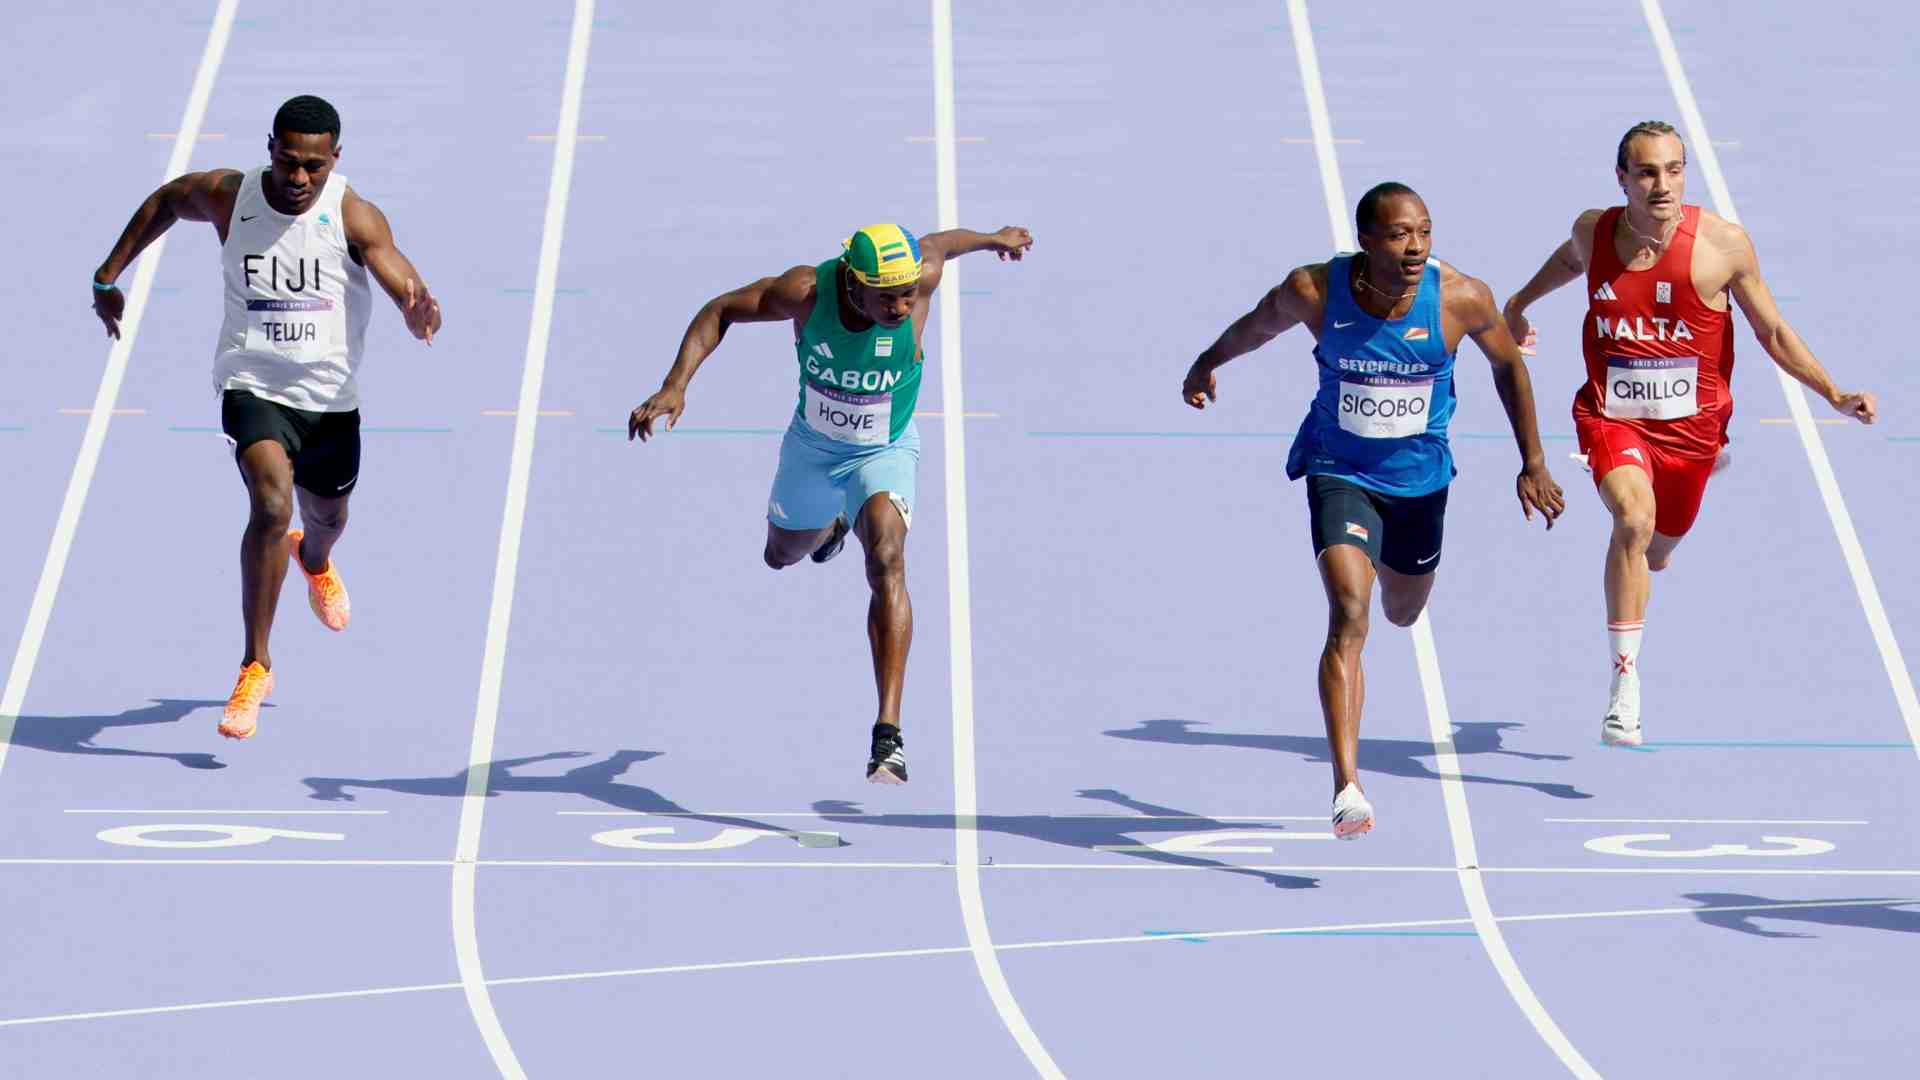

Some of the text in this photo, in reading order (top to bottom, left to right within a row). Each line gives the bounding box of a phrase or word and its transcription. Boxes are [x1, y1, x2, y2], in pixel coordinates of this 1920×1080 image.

[244, 254, 321, 293] FIJI
[262, 322, 316, 342] TEWA
[1596, 315, 1694, 341] MALTA
[806, 355, 902, 391] GABON
[1339, 358, 1430, 375] SEYCHELLES
[1613, 379, 1690, 400] GRILLO
[819, 401, 874, 430] HOYE
[1342, 393, 1425, 418] SICOBO
